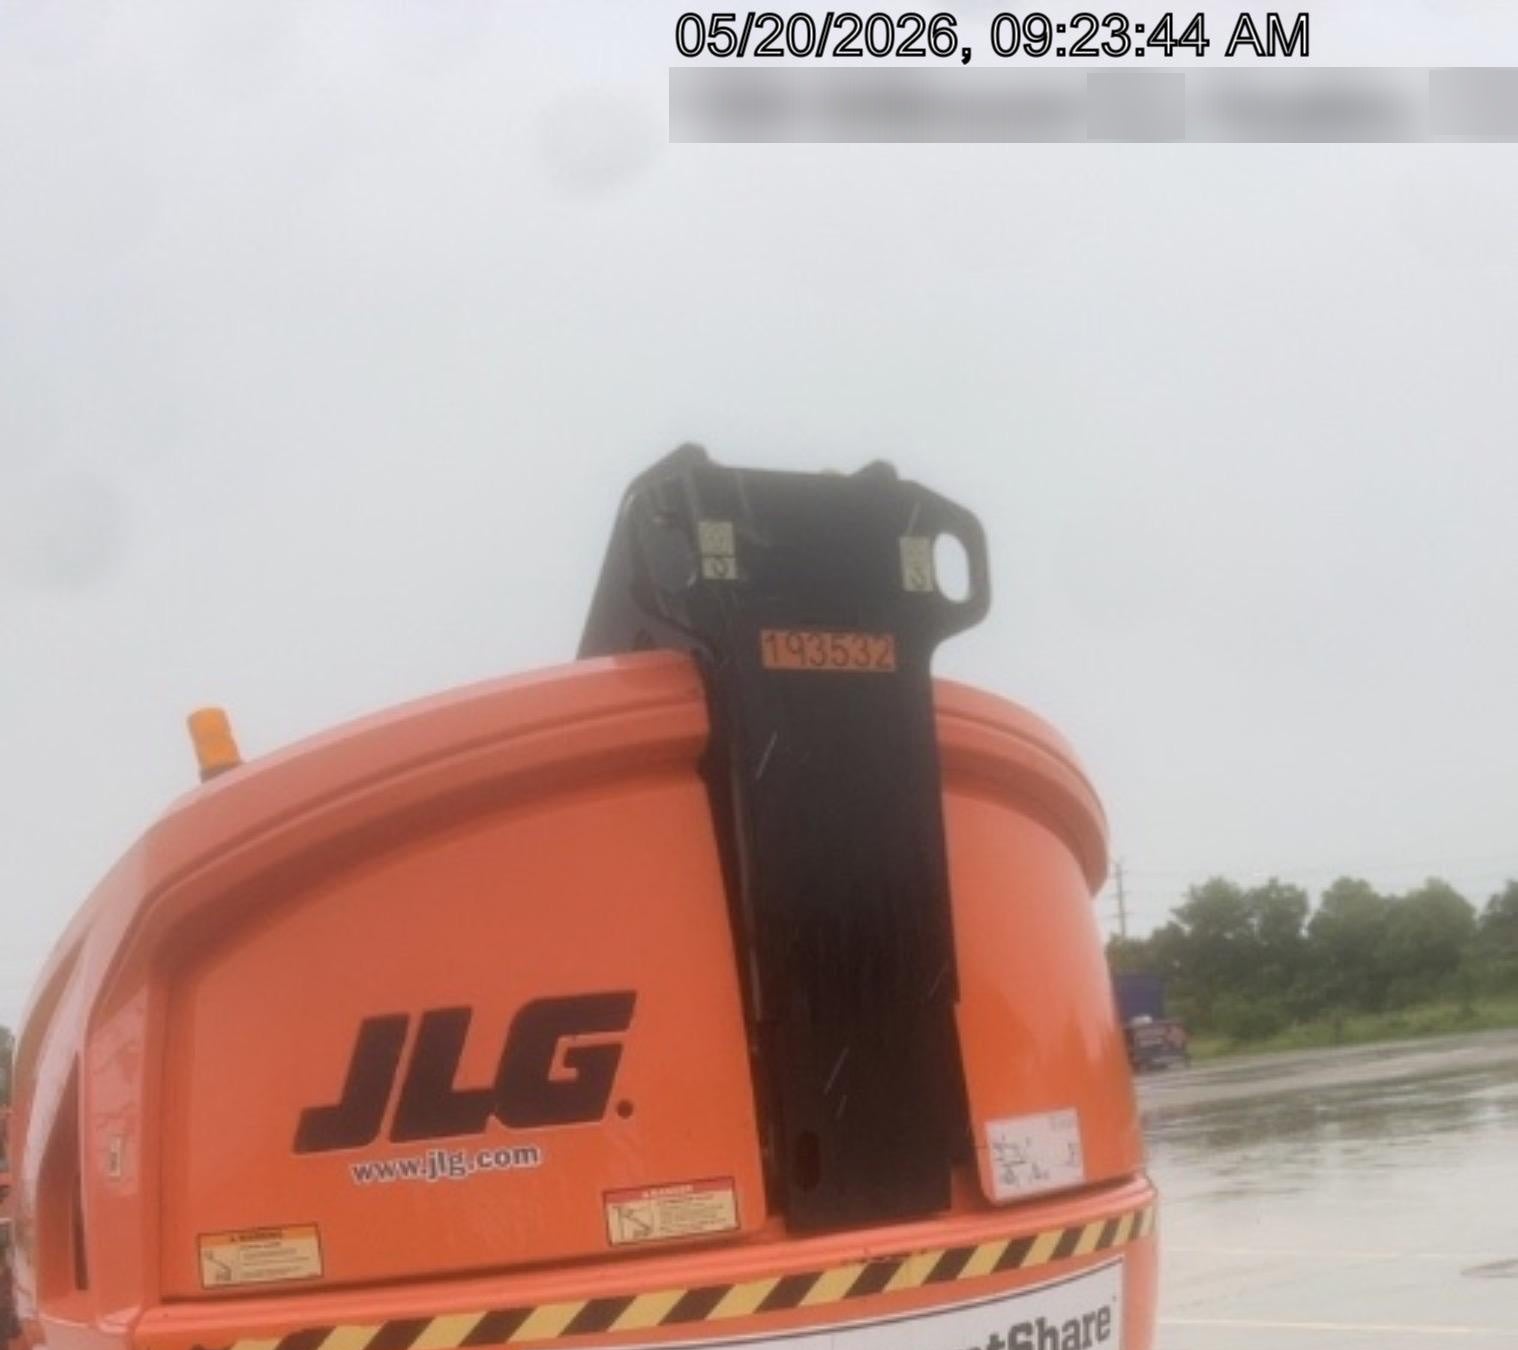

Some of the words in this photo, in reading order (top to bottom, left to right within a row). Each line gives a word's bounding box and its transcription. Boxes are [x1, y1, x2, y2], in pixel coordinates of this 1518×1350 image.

[764, 631, 891, 667] 193532
[291, 990, 637, 1155] JLG
[351, 1142, 541, 1186] www.jlg.com
